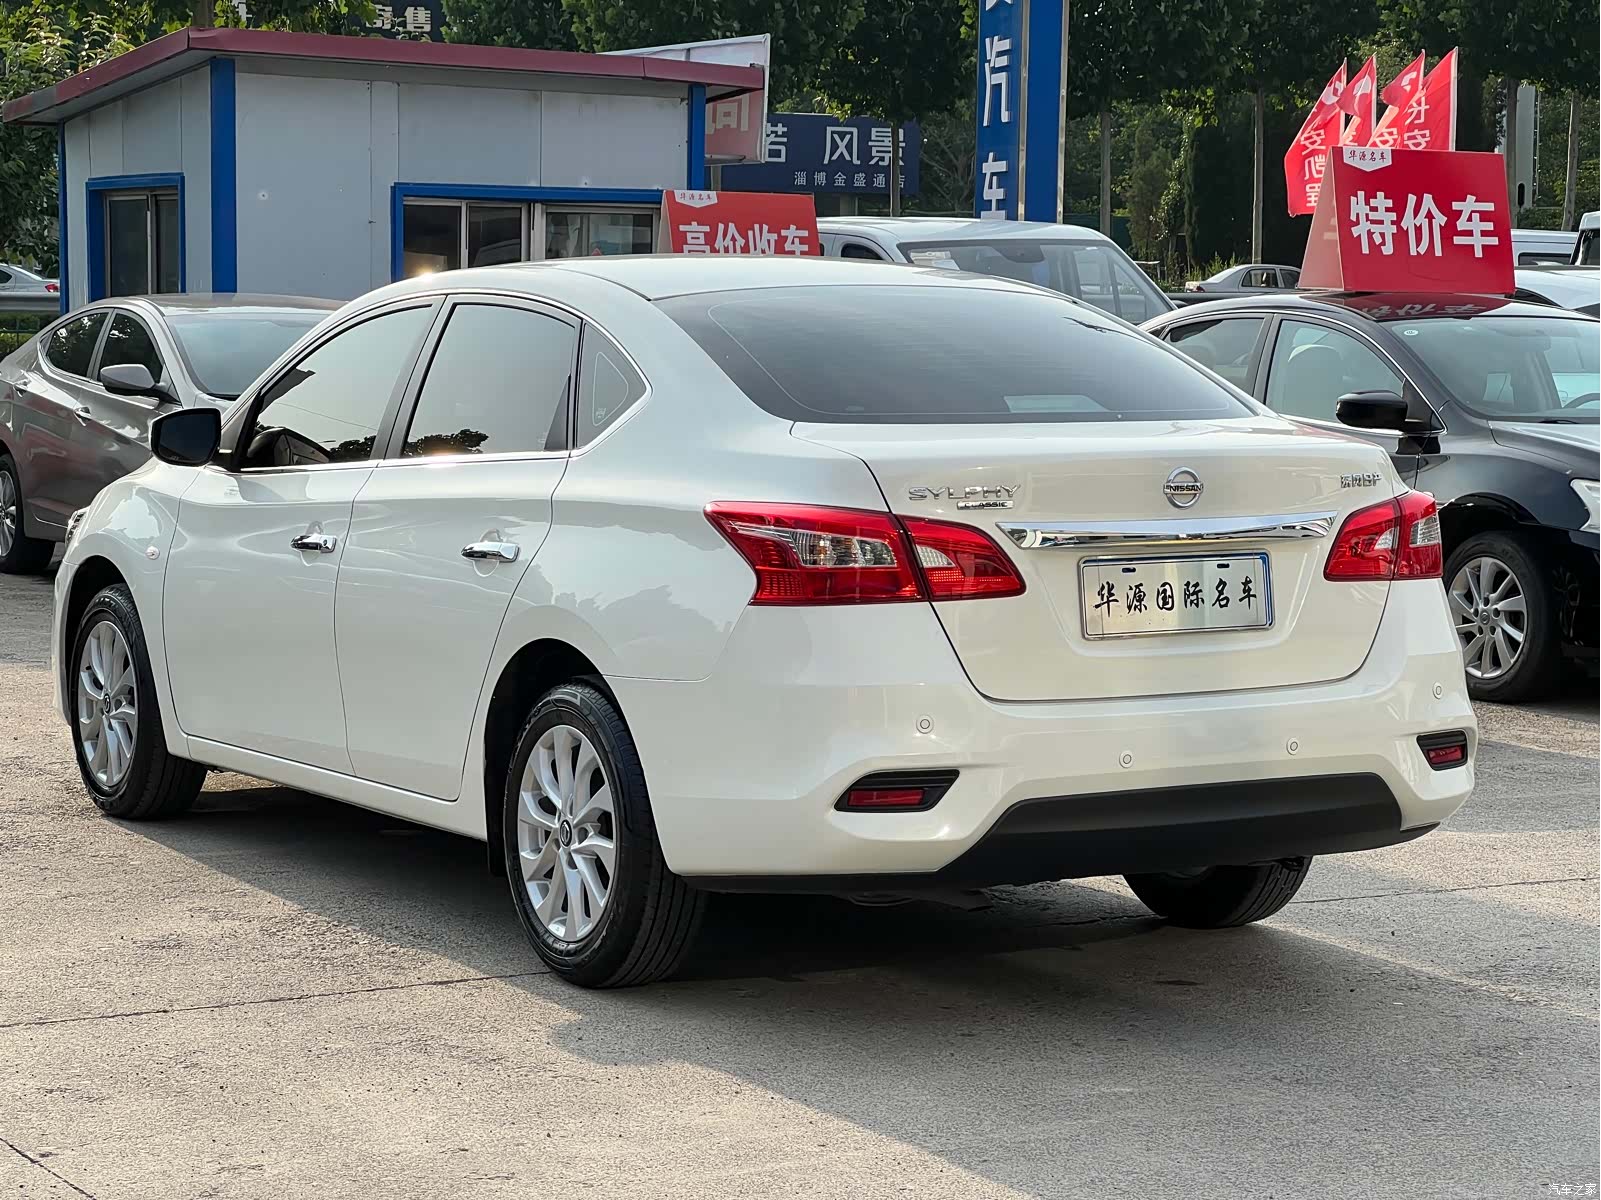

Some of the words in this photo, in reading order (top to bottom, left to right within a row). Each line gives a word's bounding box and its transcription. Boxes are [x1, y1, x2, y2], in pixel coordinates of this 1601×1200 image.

[981, 0, 1013, 220] 汽车
[823, 126, 906, 166] 风景
[1348, 150, 1387, 162] 华源名车
[679, 221, 809, 256] 高价收车
[1350, 190, 1499, 258] 特价车
[909, 484, 1021, 500] SYLPHY
[1168, 484, 1202, 492] NISSAN
[1093, 575, 1257, 618] 华源国际名车
